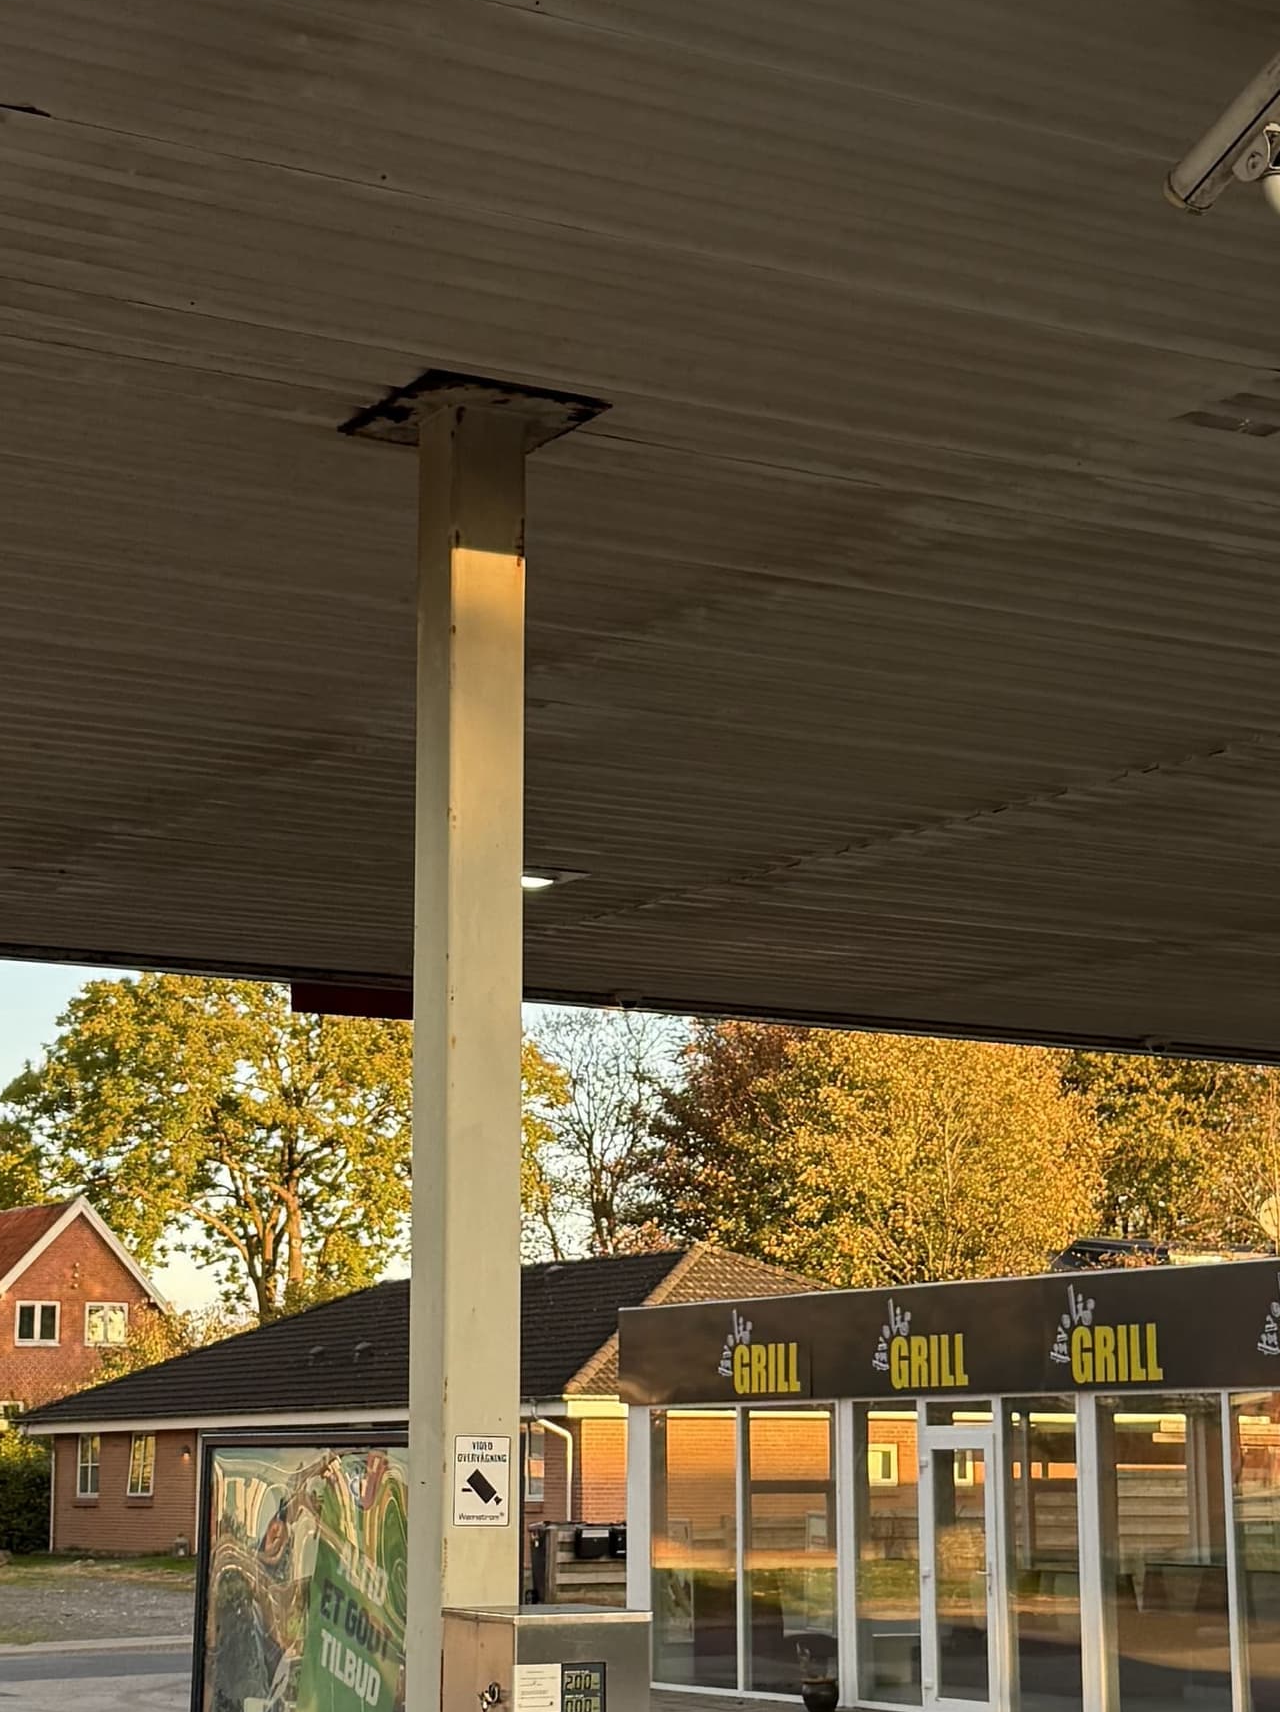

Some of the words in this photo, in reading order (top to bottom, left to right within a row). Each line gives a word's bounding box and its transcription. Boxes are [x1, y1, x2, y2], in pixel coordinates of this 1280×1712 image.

[733, 1342, 801, 1394] GRILL
[890, 1333, 969, 1389] GRILL
[1071, 1323, 1163, 1384] GRILL
[472, 1441, 493, 1451] VIDEO
[321, 1578, 345, 1625] ET
[321, 1628, 382, 1707] TILBUD
